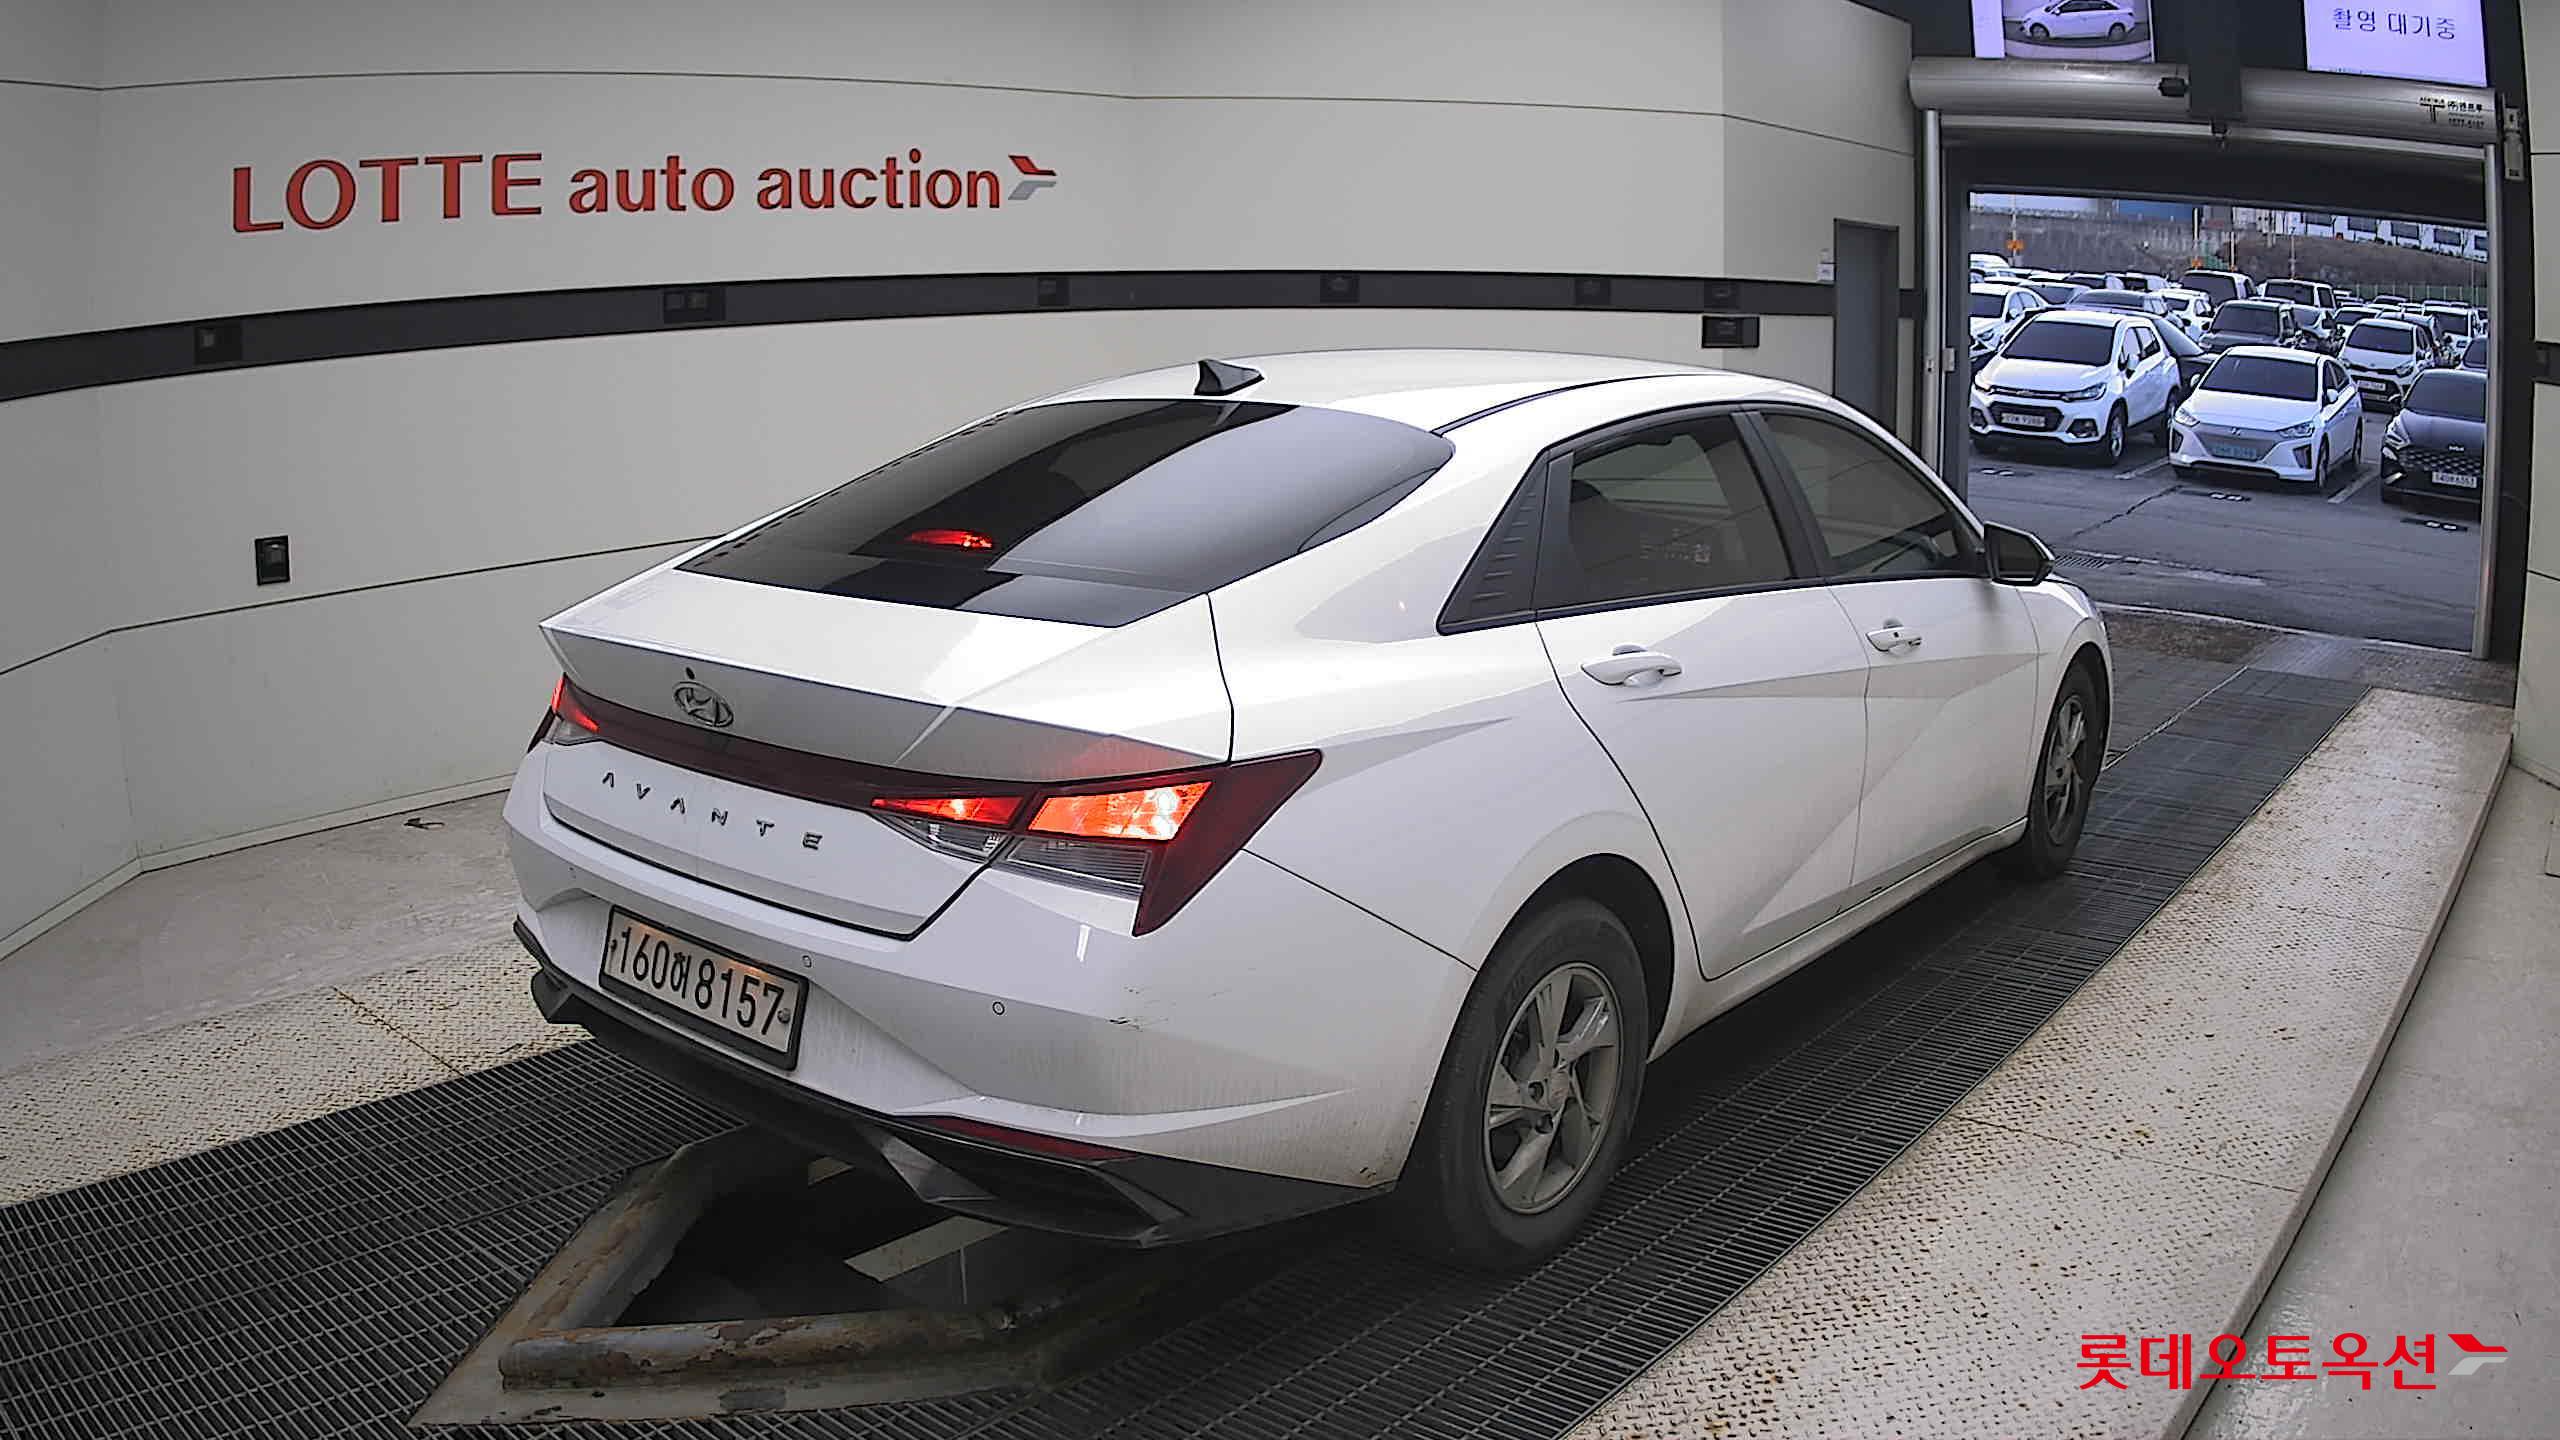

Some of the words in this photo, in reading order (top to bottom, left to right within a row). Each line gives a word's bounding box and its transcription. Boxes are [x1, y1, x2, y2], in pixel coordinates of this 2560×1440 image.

[2333, 7, 2376, 33] 촬영
[2387, 12, 2456, 41] 대기중
[232, 152, 542, 233] LOTTE
[568, 154, 735, 215] auto
[755, 147, 1001, 210] auction
[601, 771, 823, 851] AVANTE
